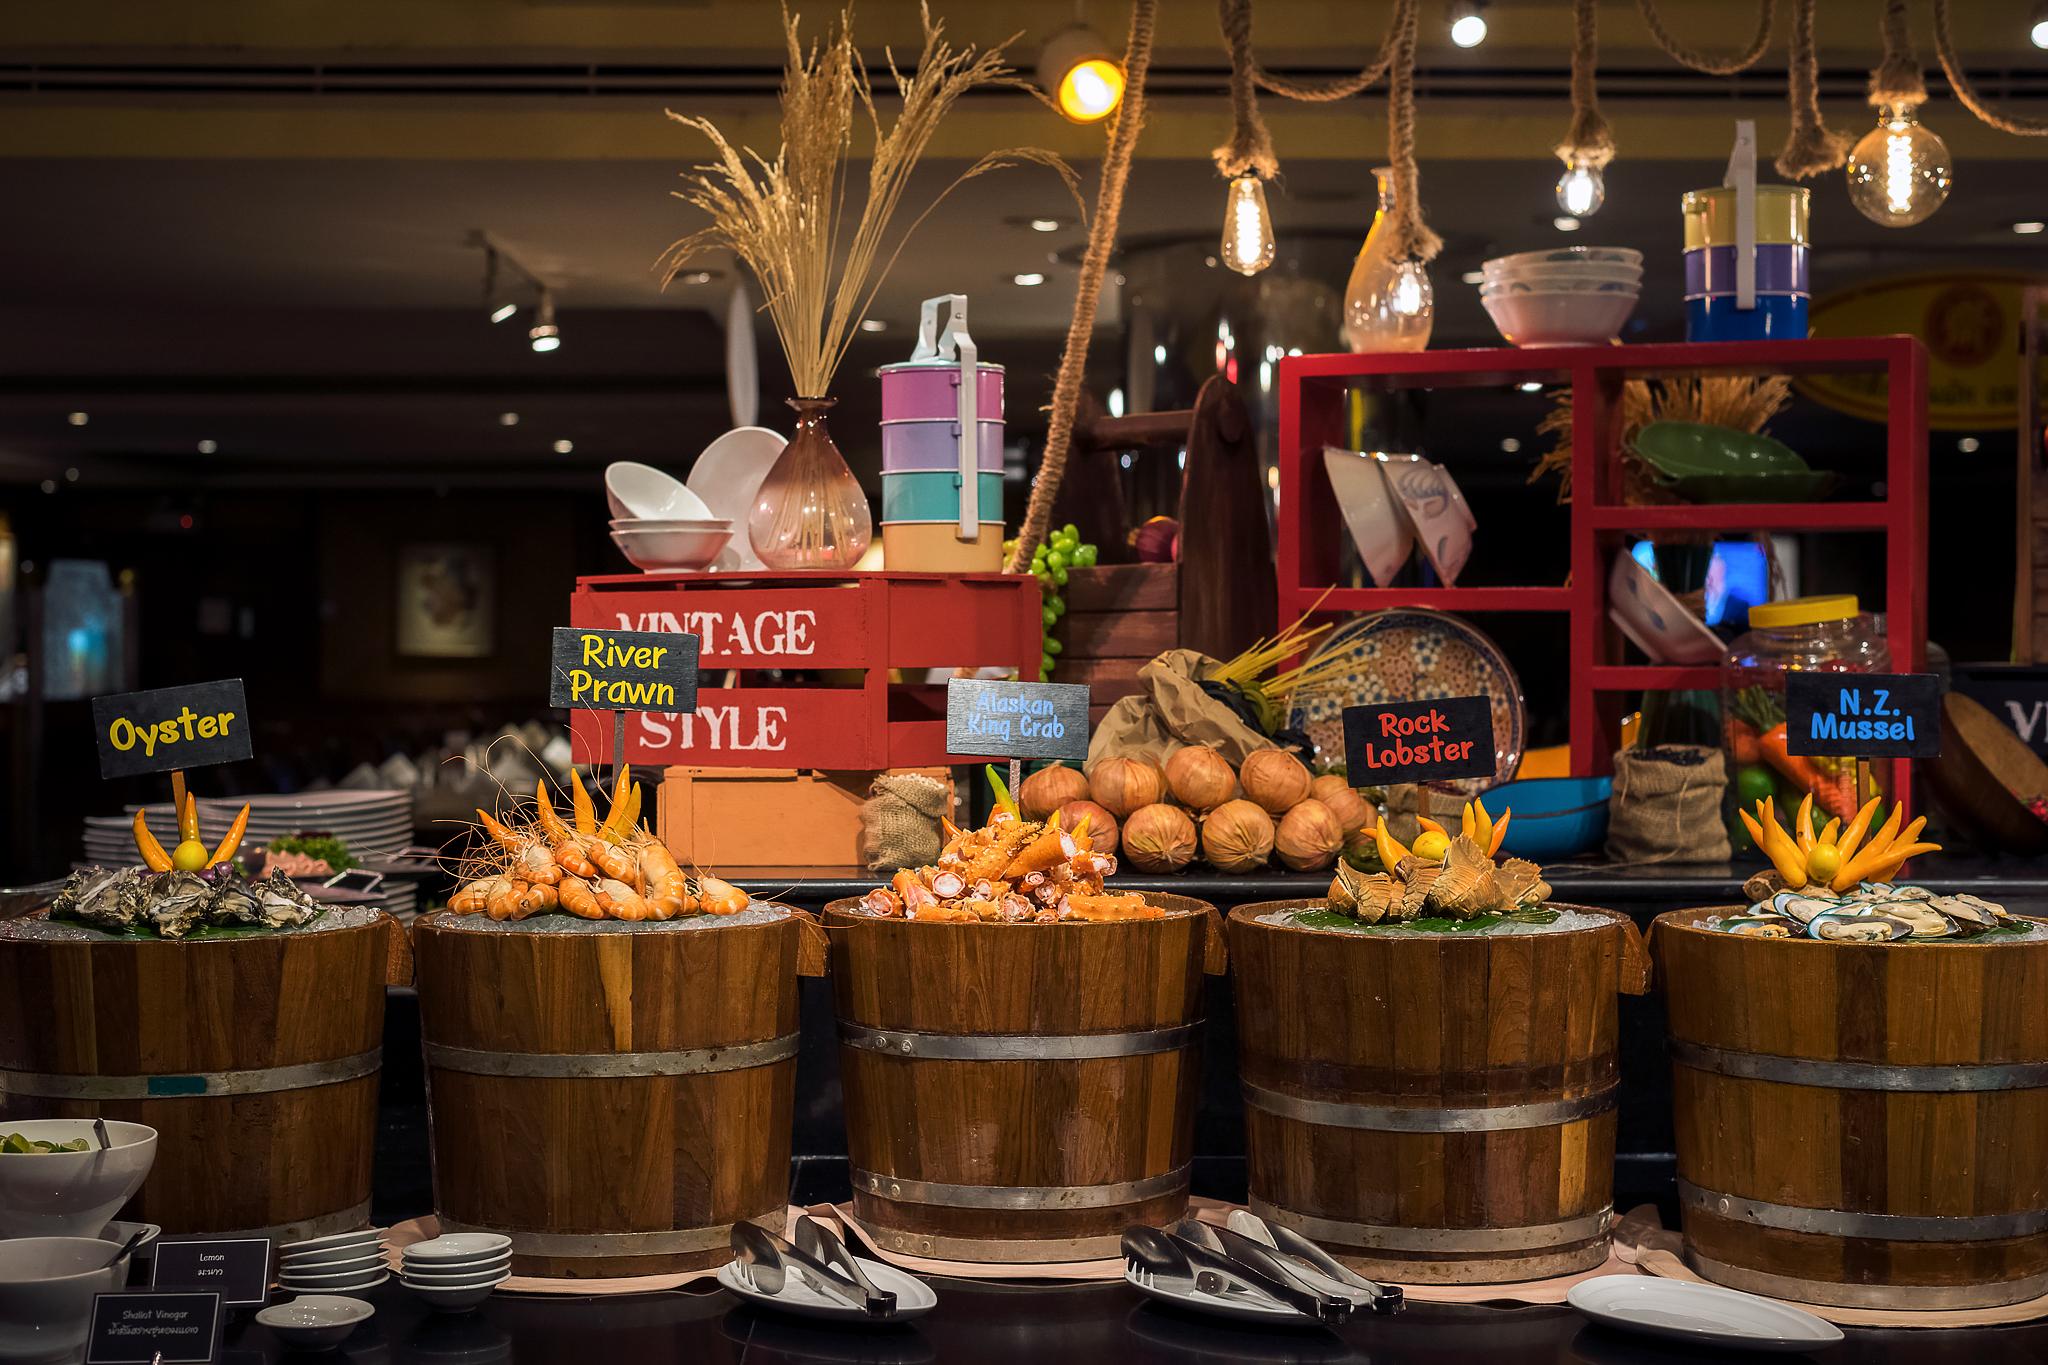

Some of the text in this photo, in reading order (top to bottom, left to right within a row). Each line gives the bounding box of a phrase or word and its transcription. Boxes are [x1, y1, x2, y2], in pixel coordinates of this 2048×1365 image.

[580, 634, 668, 669] River
[569, 669, 675, 706] Prawn
[975, 690, 1054, 715] Alaskan
[1840, 688, 1901, 716] N.Z.
[109, 706, 235, 757] Oyster
[639, 706, 788, 751] STYLE
[967, 711, 1065, 742] King Crab
[1378, 709, 1450, 738] Rock
[1811, 712, 1915, 741] Mussel
[1366, 735, 1474, 769] Lobster
[200, 1253, 225, 1262] Lemon
